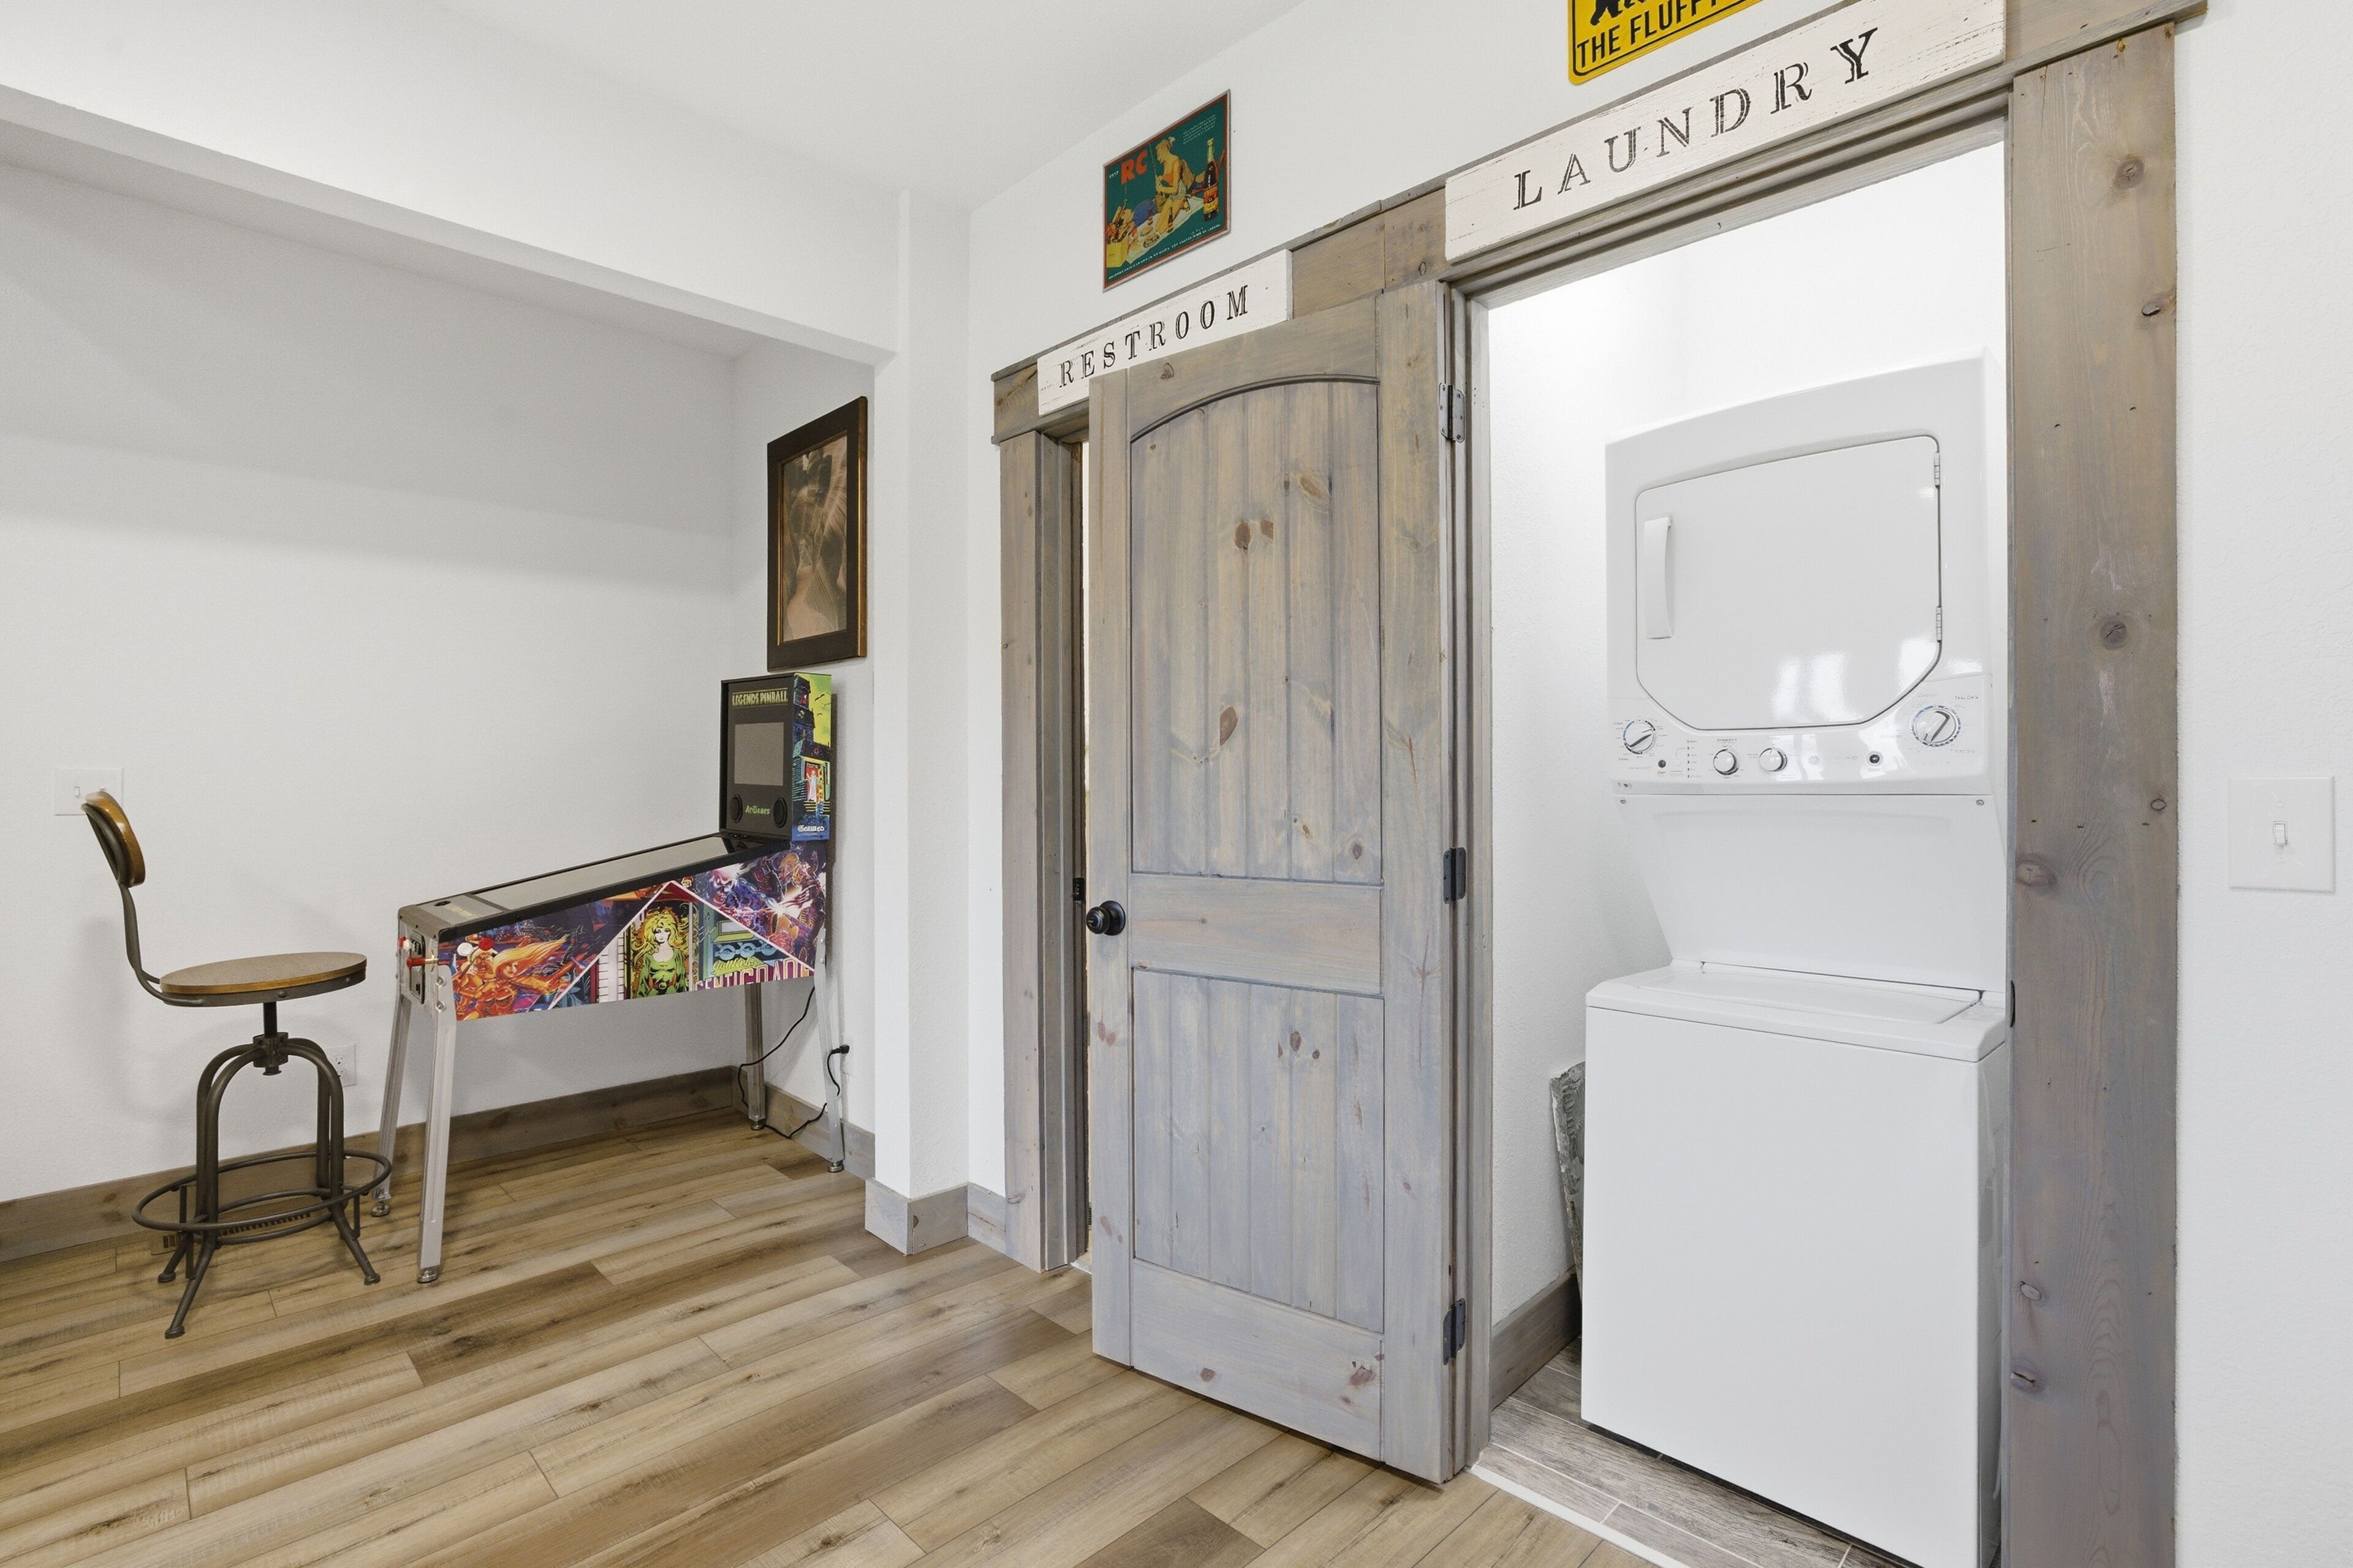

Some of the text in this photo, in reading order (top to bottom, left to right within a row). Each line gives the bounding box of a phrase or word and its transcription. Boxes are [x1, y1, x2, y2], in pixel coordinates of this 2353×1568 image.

[1577, 0, 1716, 68] THE FLUFF
[1513, 27, 1878, 211] LAUNDRY
[1121, 150, 1148, 184] RC
[1059, 285, 1248, 388] RESTROOM
[732, 691, 788, 706] LEGENDS PINBALL
